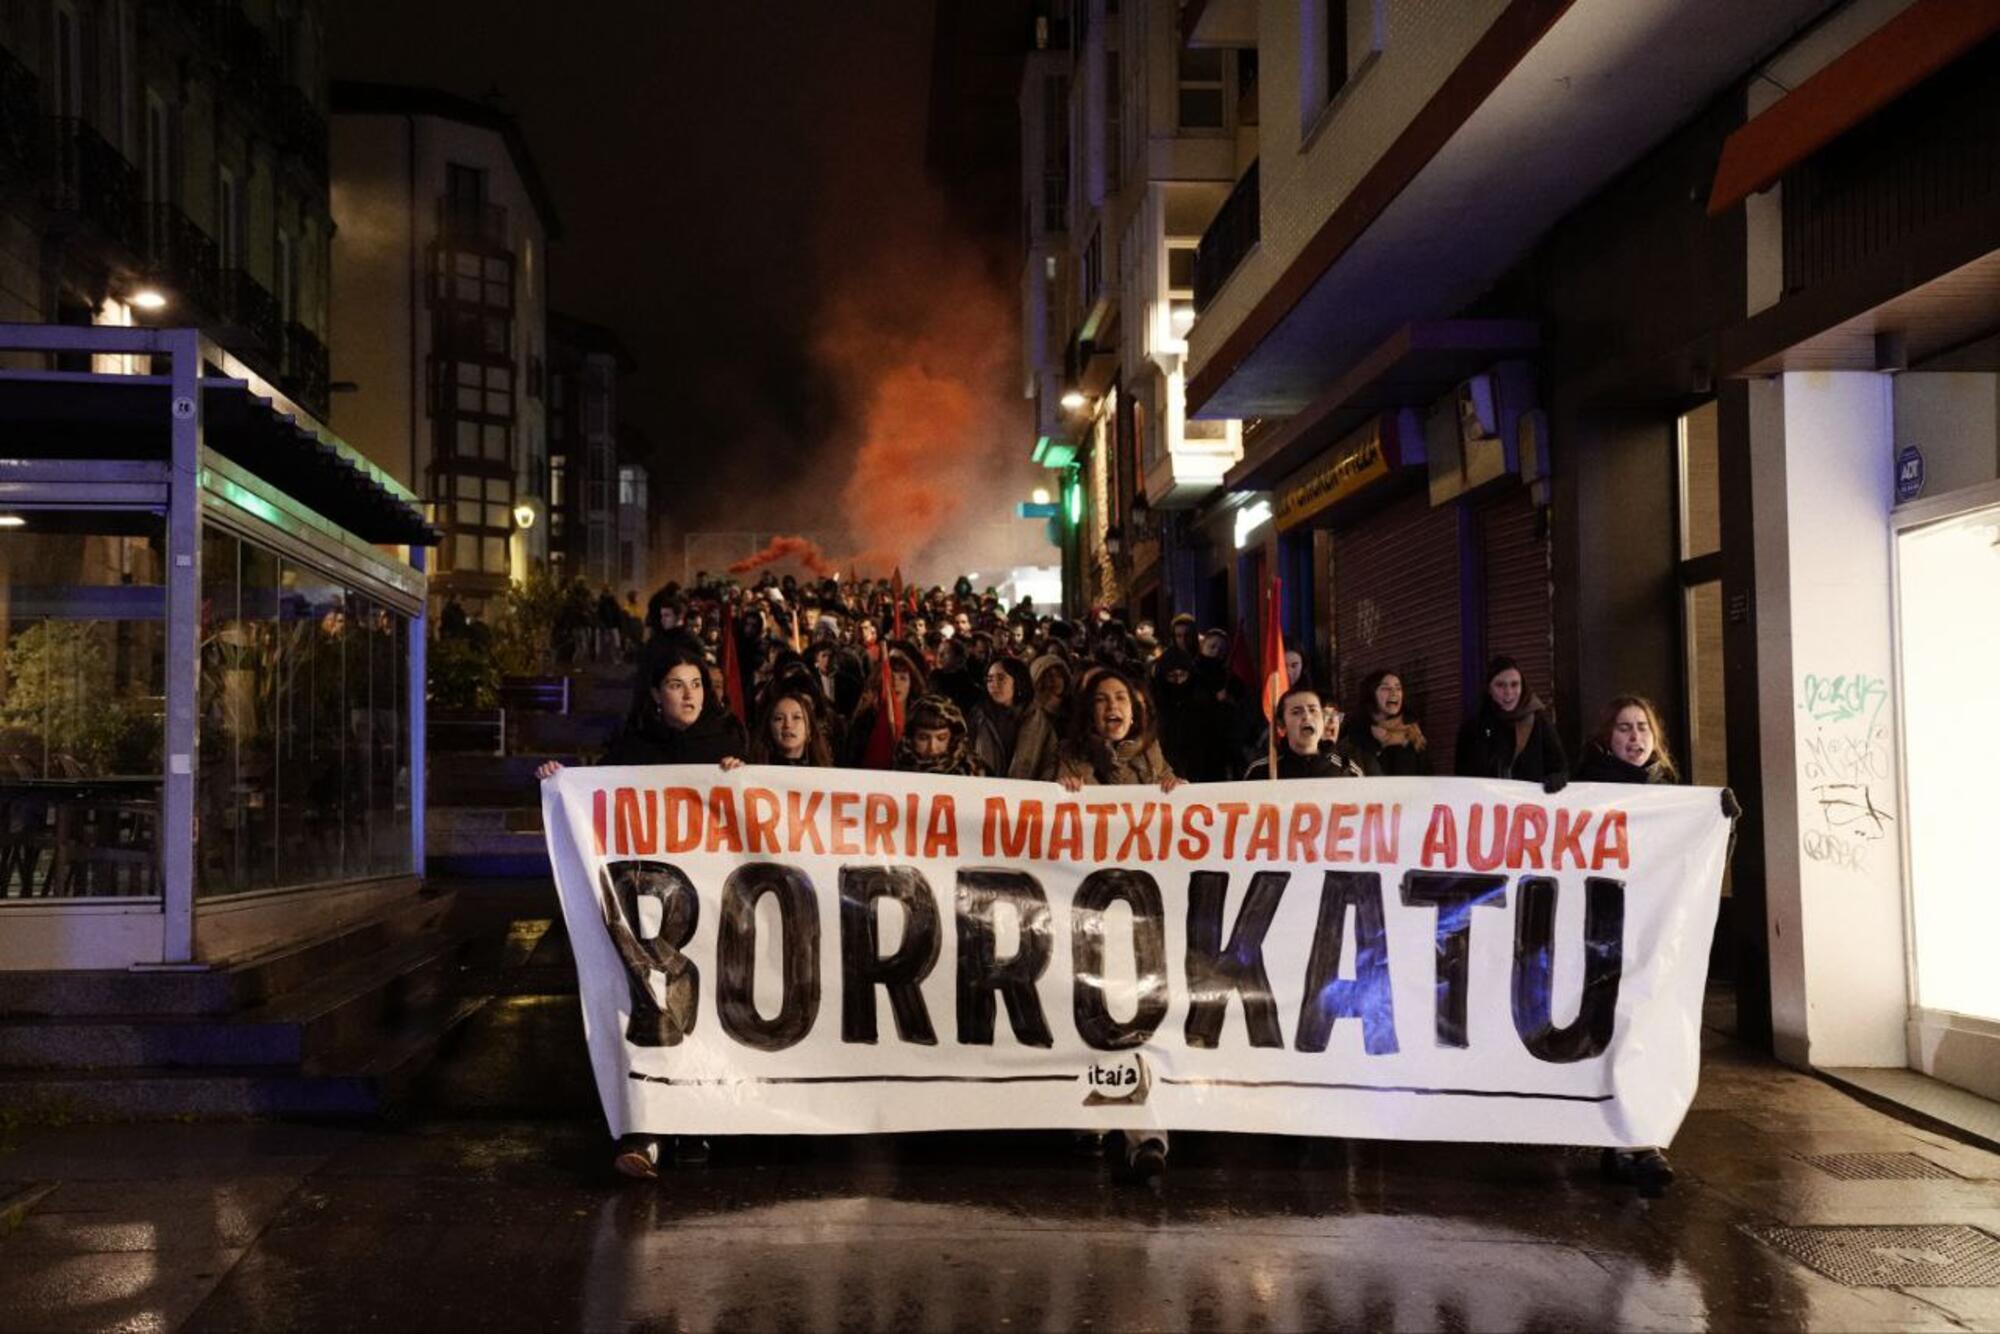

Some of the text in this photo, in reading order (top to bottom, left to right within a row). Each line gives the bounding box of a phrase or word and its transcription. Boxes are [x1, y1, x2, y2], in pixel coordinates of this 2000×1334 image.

[593, 786, 1631, 871] INDARKERIA MATXISTAREN AURKA
[600, 860, 1626, 1064] BORROKATU
